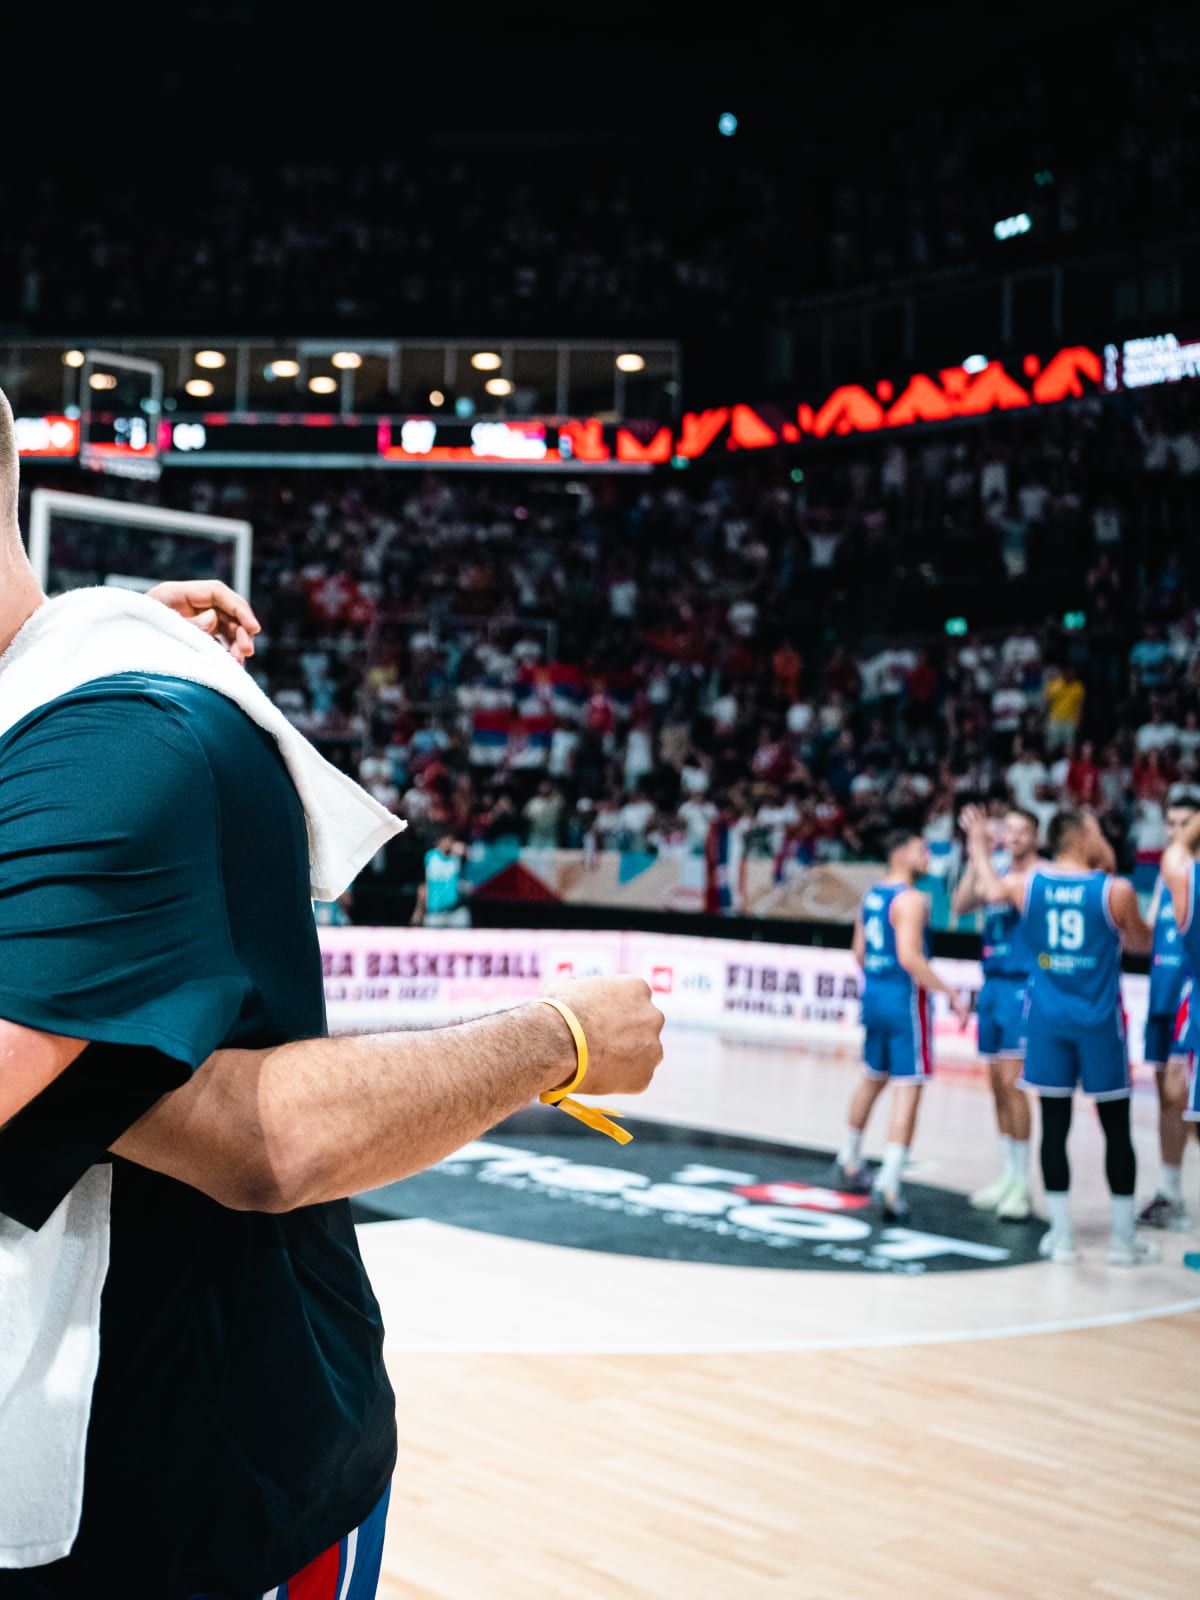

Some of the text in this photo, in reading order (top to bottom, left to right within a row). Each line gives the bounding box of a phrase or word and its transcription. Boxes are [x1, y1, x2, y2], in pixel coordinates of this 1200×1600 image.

[1047, 908, 1085, 951] 19
[366, 952, 540, 978] BASKETBALL
[728, 963, 801, 995] FIBA
